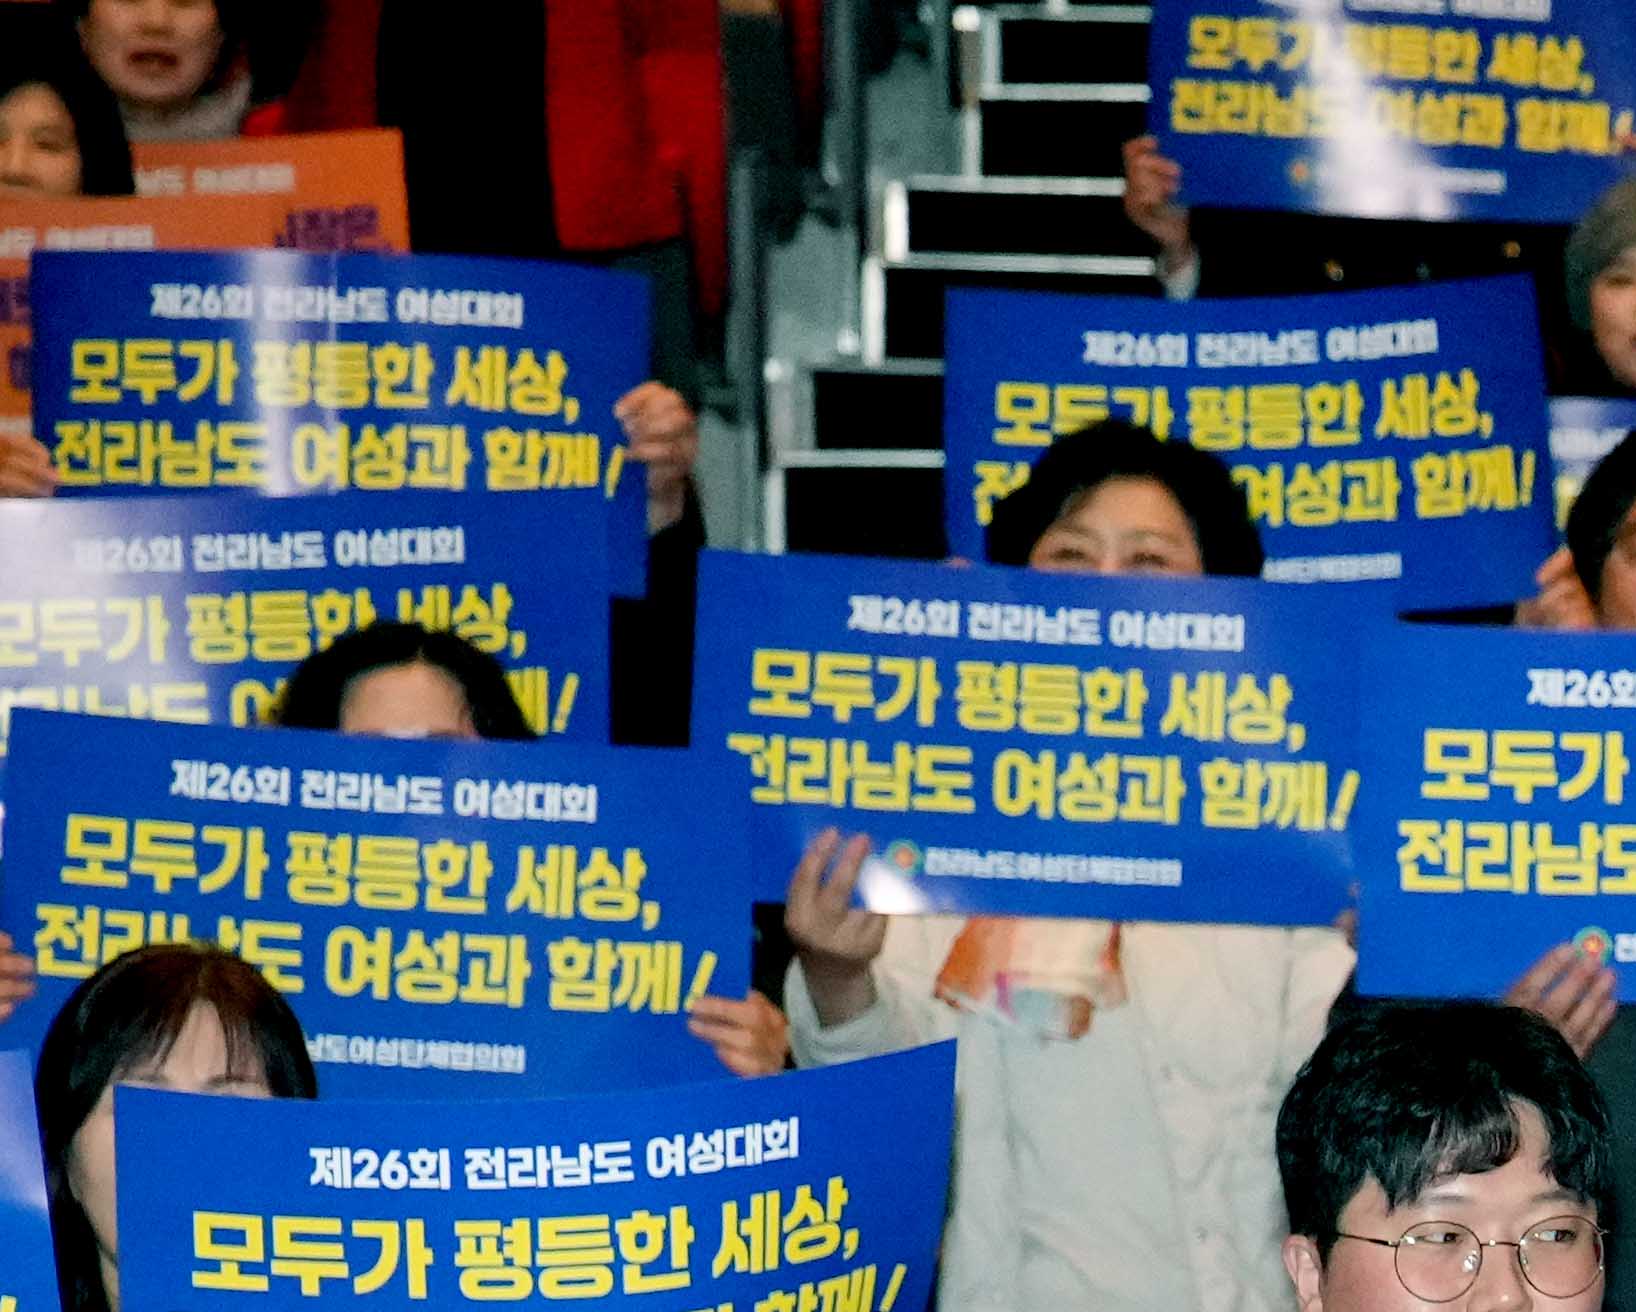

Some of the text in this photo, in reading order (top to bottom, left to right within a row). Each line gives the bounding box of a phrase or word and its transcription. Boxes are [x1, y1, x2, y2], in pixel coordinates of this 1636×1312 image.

[71, 338, 241, 406] 모두가
[445, 345, 580, 425] 세상,
[1082, 330, 1189, 368] 제26회
[1185, 368, 1494, 451] 평등한 세상,
[54, 420, 275, 488] 전라남도
[292, 424, 473, 498] 여성과
[1411, 445, 1535, 519] 함께!
[847, 595, 1246, 653] 제26회 전라남도 여성대회
[749, 649, 1306, 753] 모두가 평등한 세상,
[169, 759, 598, 824] 제26회 전라남도 여성대회
[727, 733, 1361, 832] 전라남도 여성과 함께!
[1420, 728, 1630, 805] 모두가
[60, 813, 661, 931] 모두가 평등한 세상,
[324, 925, 717, 1016] 여성과 함께!
[309, 1116, 799, 1191] 제26회 전라남도 여성대회
[191, 1176, 859, 1301] 모두가 평등한 세상,
